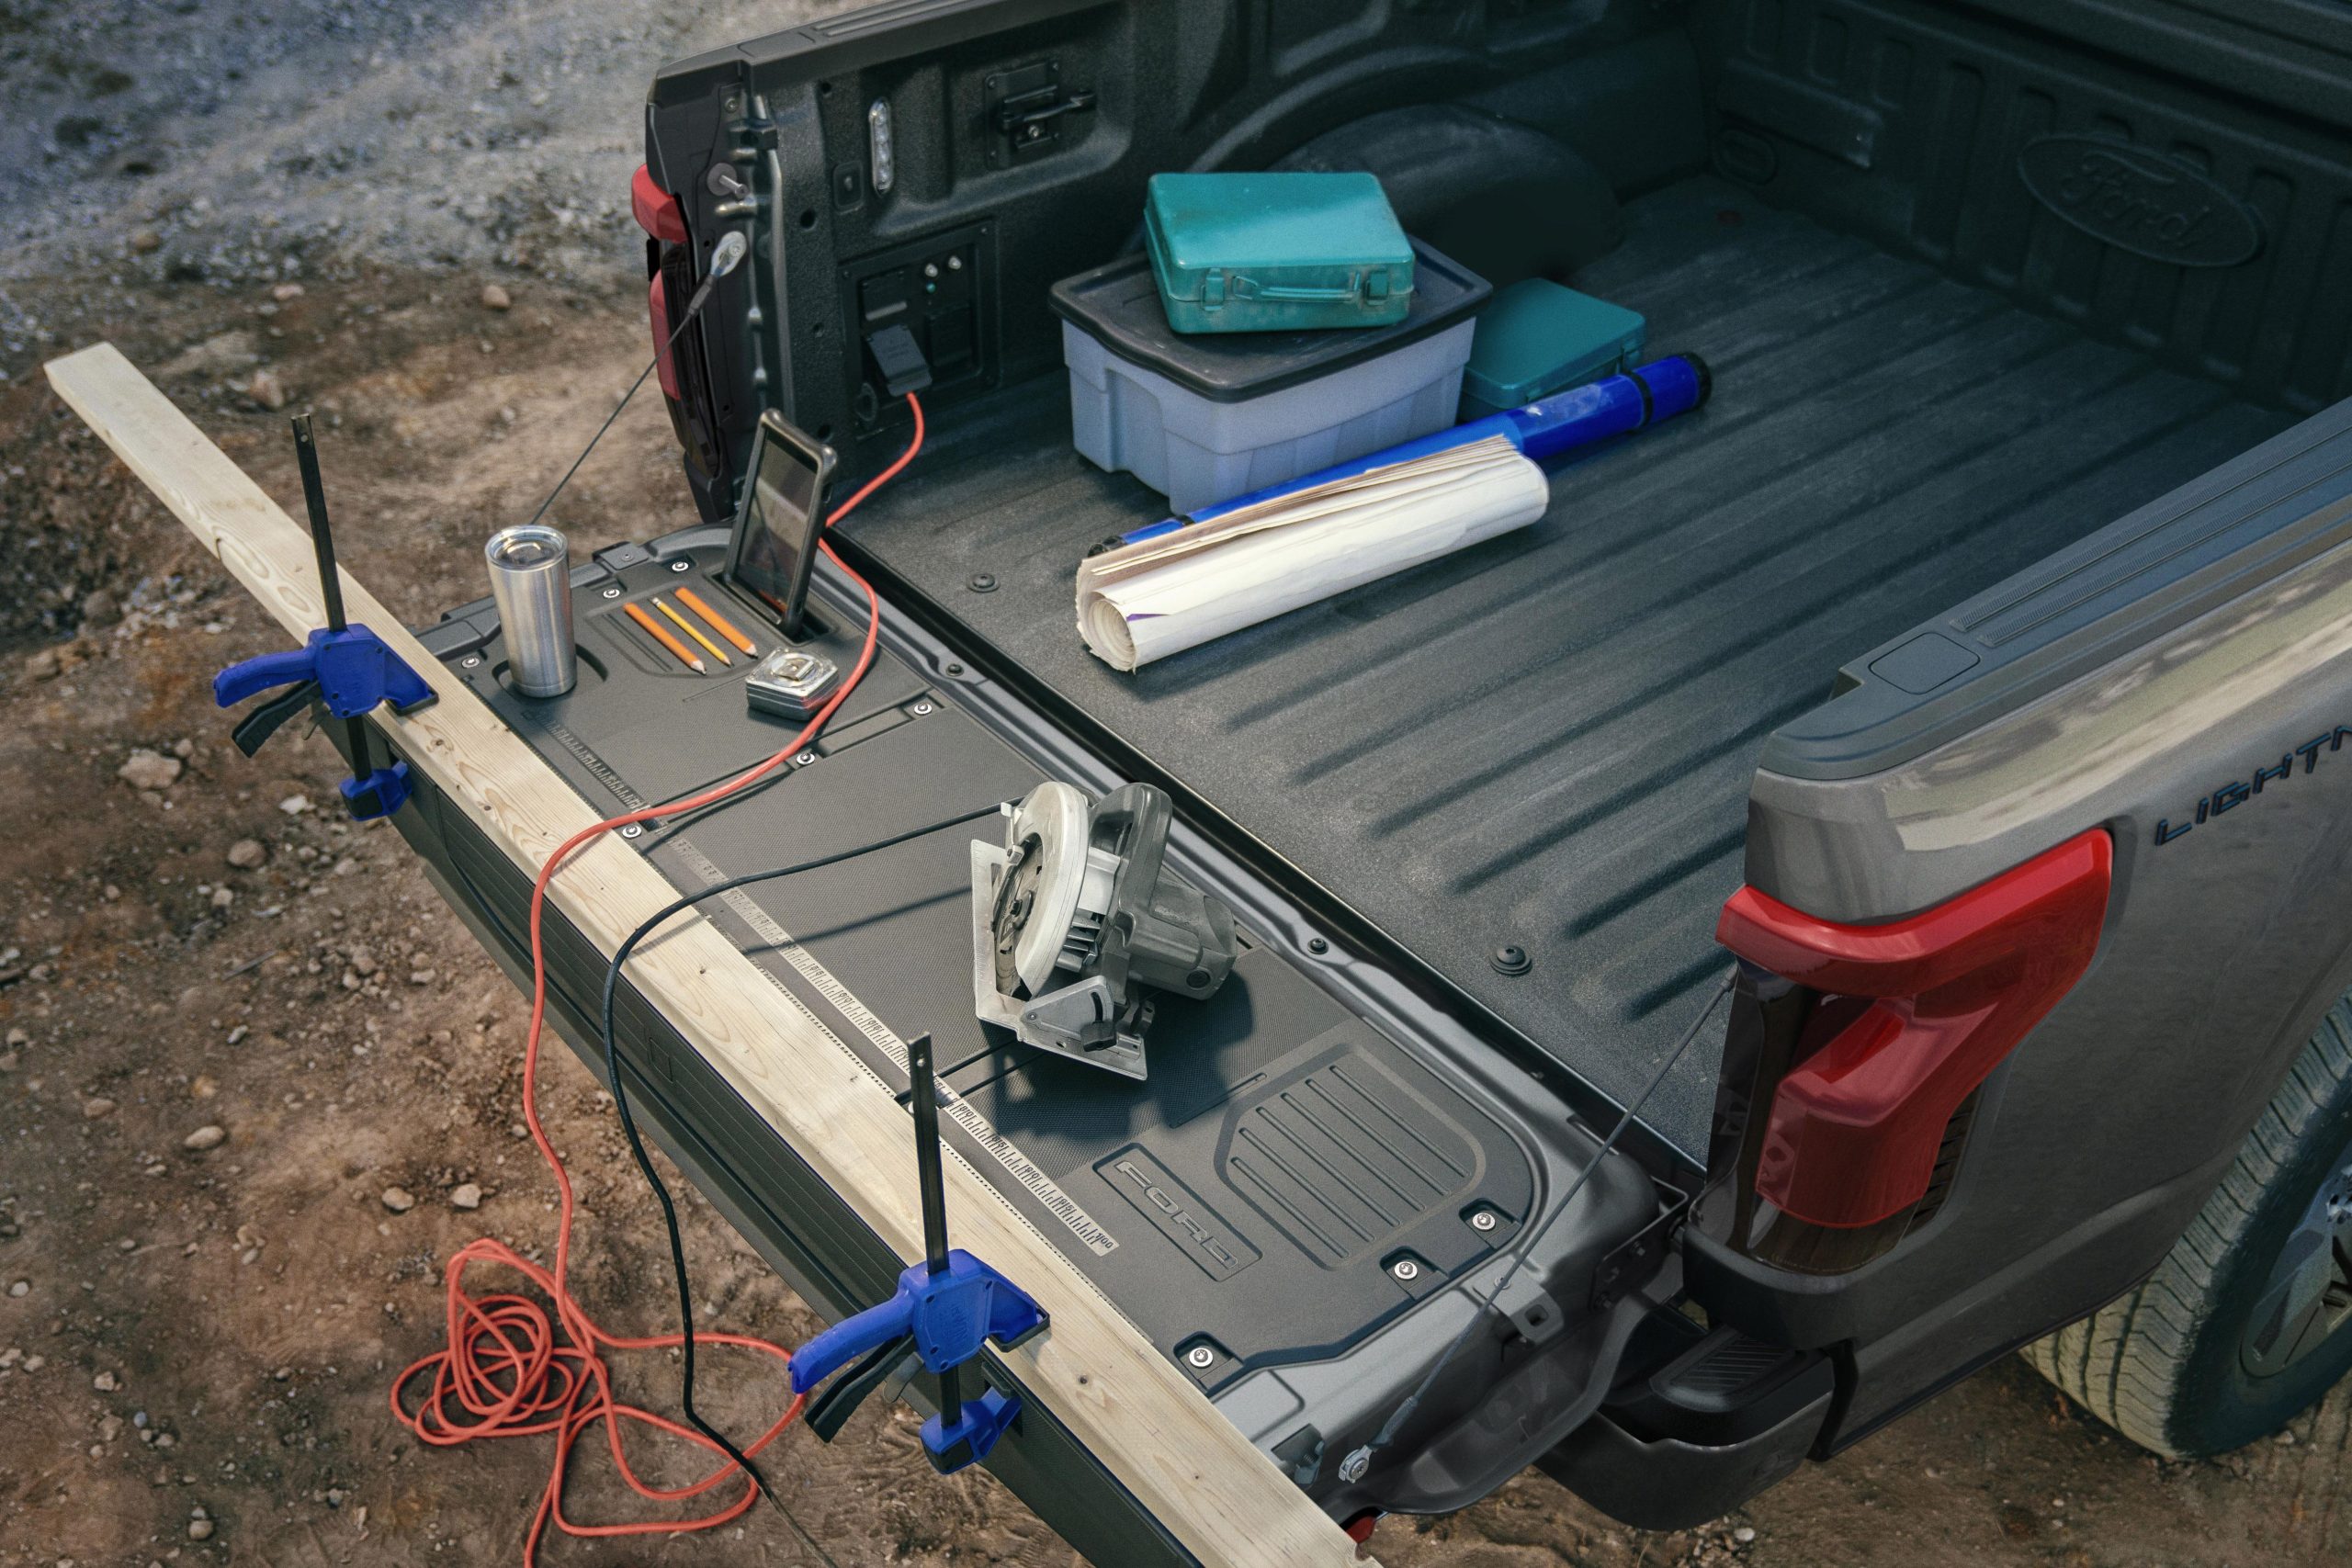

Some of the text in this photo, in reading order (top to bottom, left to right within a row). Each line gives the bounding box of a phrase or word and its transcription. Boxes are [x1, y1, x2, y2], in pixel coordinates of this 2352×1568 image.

[2061, 148, 2212, 249] Ford
[1096, 1233, 1114, 1249] 100
[1114, 1160, 1238, 1269] FORD
